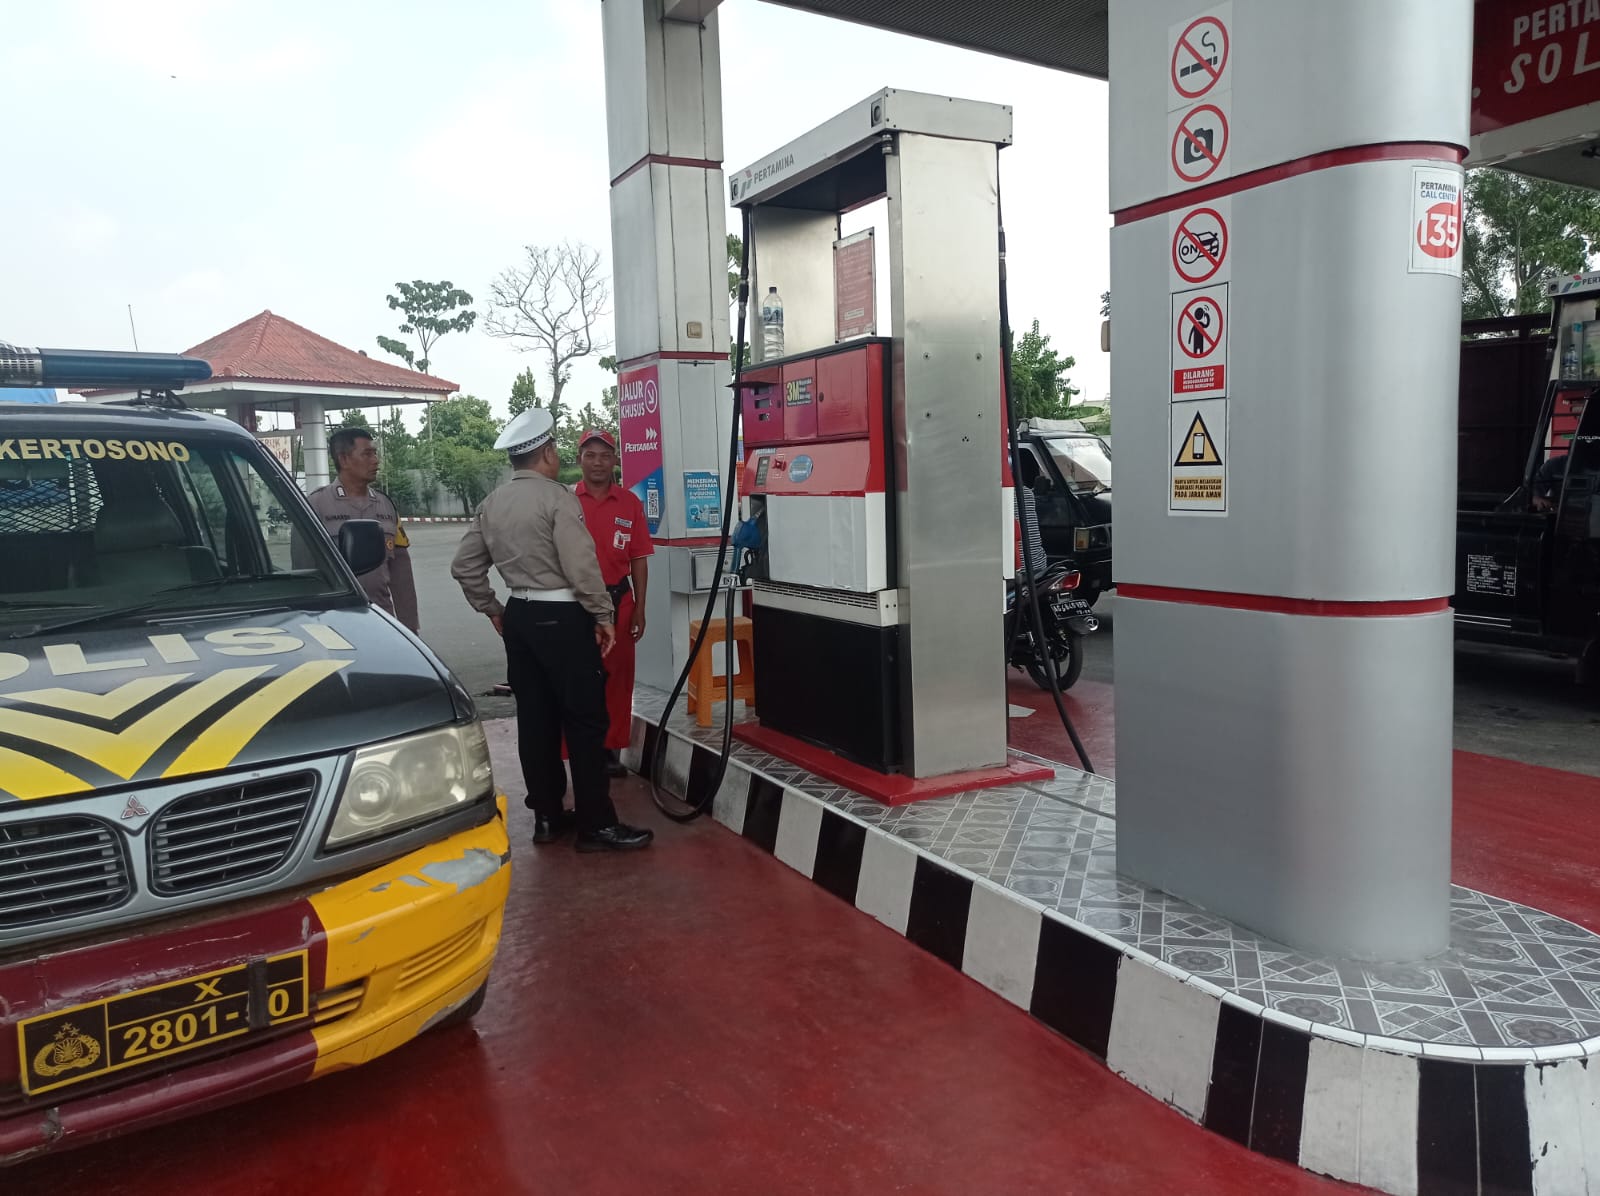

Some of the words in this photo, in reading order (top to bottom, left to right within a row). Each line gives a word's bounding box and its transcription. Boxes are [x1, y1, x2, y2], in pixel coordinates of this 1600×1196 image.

[754, 154, 794, 184] PERTAMINA
[1420, 181, 1457, 193] PERTAMINA
[1420, 190, 1438, 200] CALL
[1420, 213, 1458, 249] 135
[1181, 244, 1198, 256] ON
[1183, 369, 1215, 380] DILARANG
[621, 380, 644, 402] JALUR
[786, 381, 800, 401] 3M
[621, 402, 645, 419] KHUSUS
[0, 439, 190, 462] KERTOSONO
[625, 441, 658, 453] PERTAMAX
[0, 624, 357, 681] LISI
[194, 977, 223, 1002] X
[123, 989, 290, 1060] 2801-0
